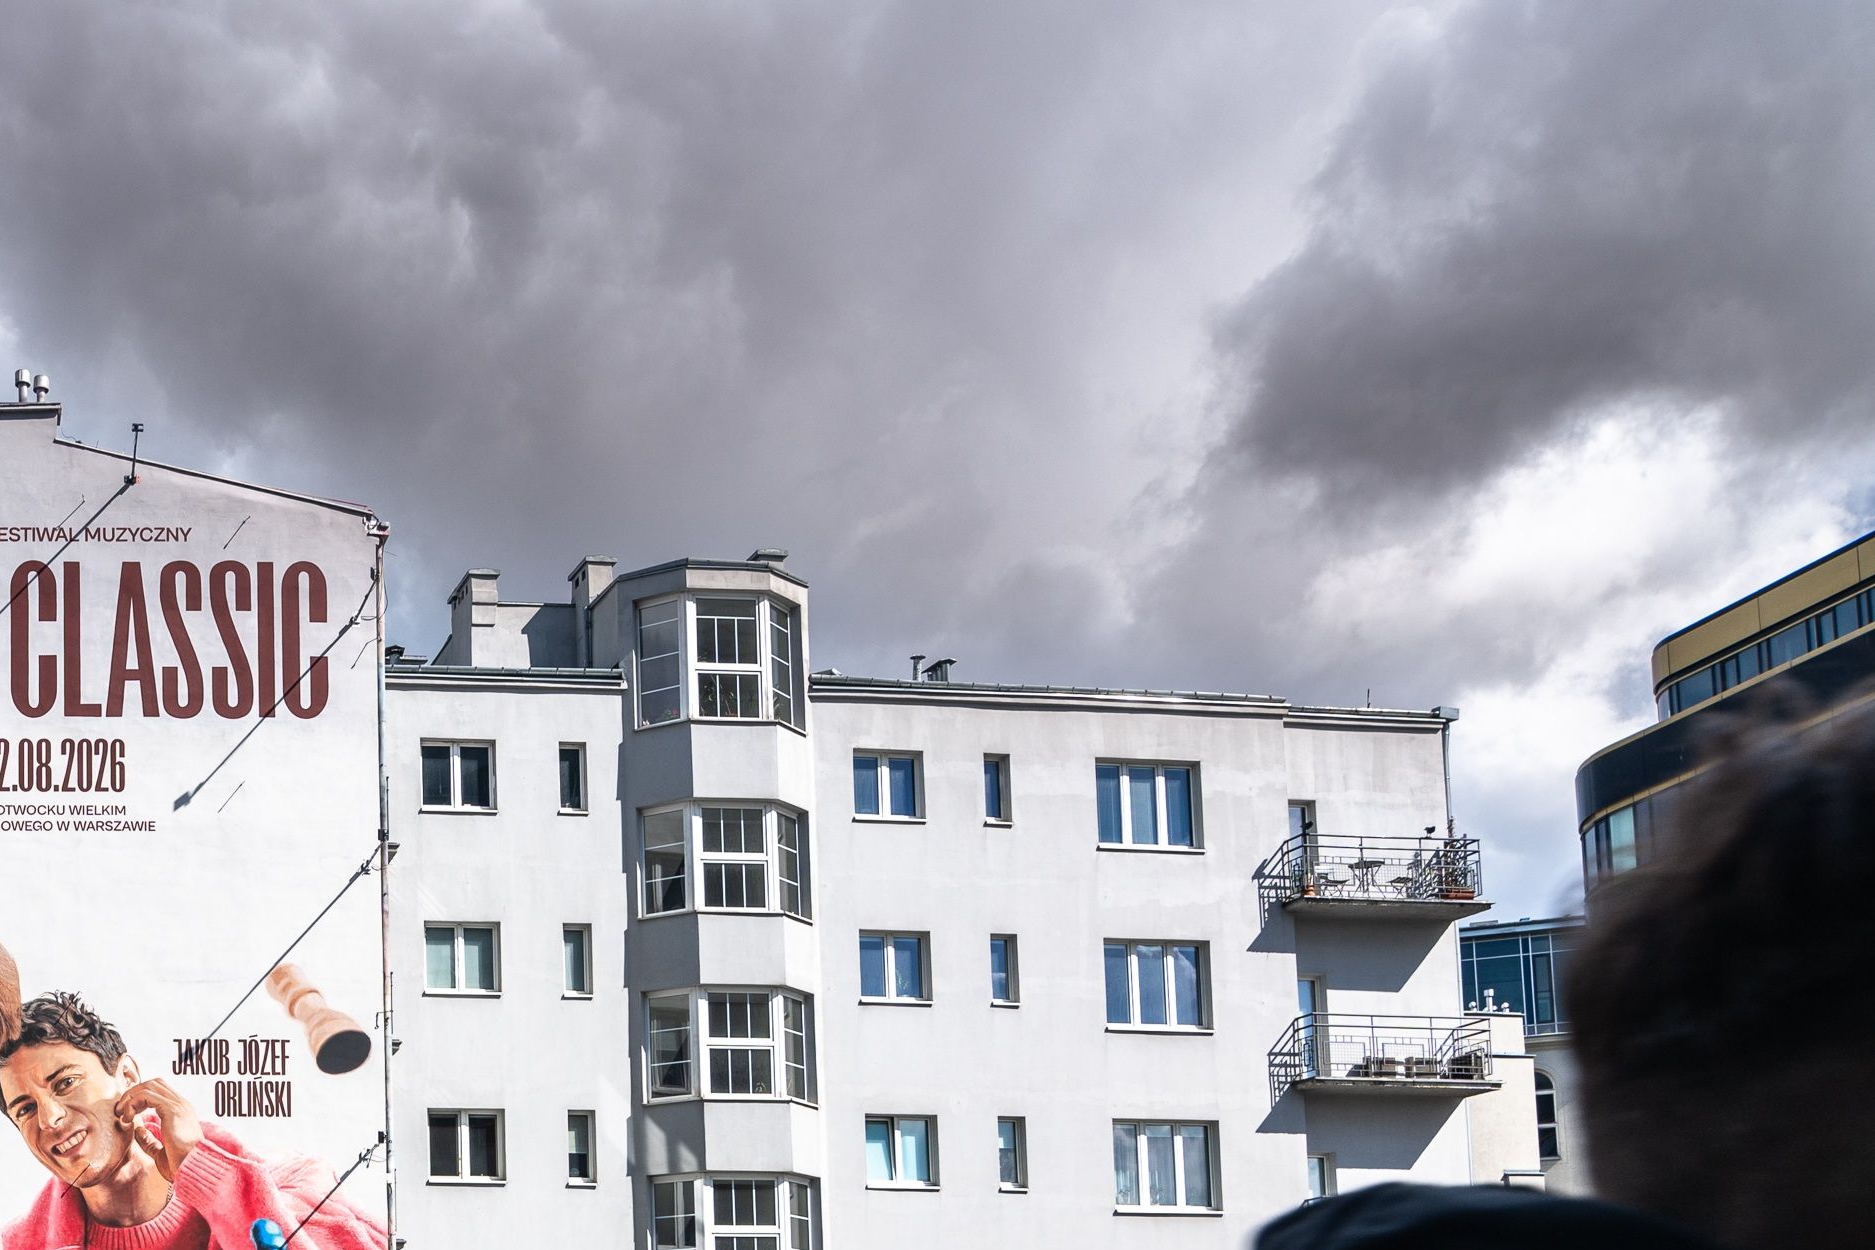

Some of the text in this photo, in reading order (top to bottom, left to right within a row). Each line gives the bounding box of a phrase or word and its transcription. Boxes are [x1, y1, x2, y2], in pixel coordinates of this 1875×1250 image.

[84, 526, 193, 543] MUZYCZNY
[9, 560, 330, 719] CLASSIC
[68, 804, 126, 816] WIELKIM
[56, 820, 71, 832] W
[73, 820, 156, 832] WARSZAWIE
[172, 1034, 290, 1076] JAKUB JÓZEF
[214, 1077, 292, 1118] ORLIŃSKI
